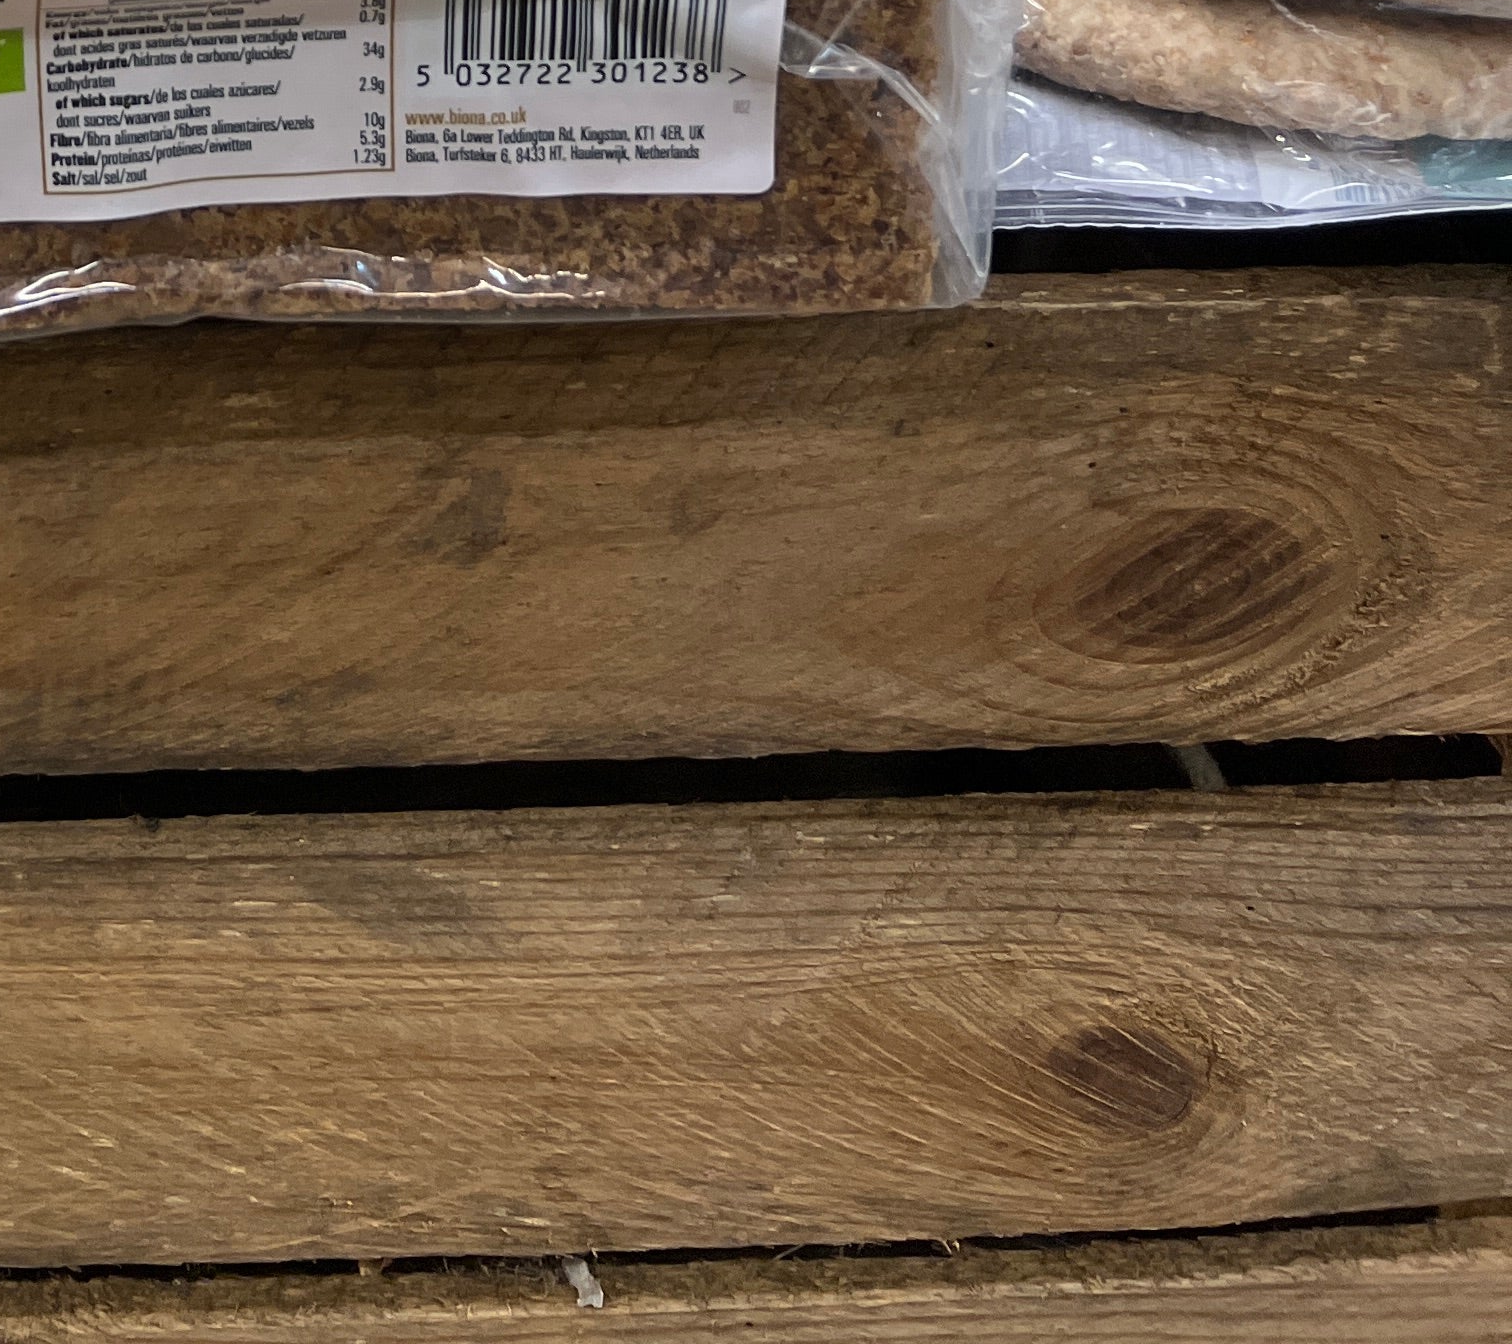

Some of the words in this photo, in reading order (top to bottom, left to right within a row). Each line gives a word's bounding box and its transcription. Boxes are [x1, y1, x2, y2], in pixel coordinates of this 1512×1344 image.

[359, 10, 386, 26] 0.7g
[363, 42, 385, 60] 34g
[359, 76, 385, 94] 2.9g
[416, 64, 431, 87] 5
[364, 111, 386, 130] 10g
[405, 106, 527, 126] www.biona.co.uk
[359, 130, 386, 149] 5.3g
[460, 128, 494, 144] Lower
[498, 127, 555, 146] Teddington
[634, 125, 656, 141] KT1
[689, 124, 706, 140] UK
[353, 148, 387, 168] 1.23g
